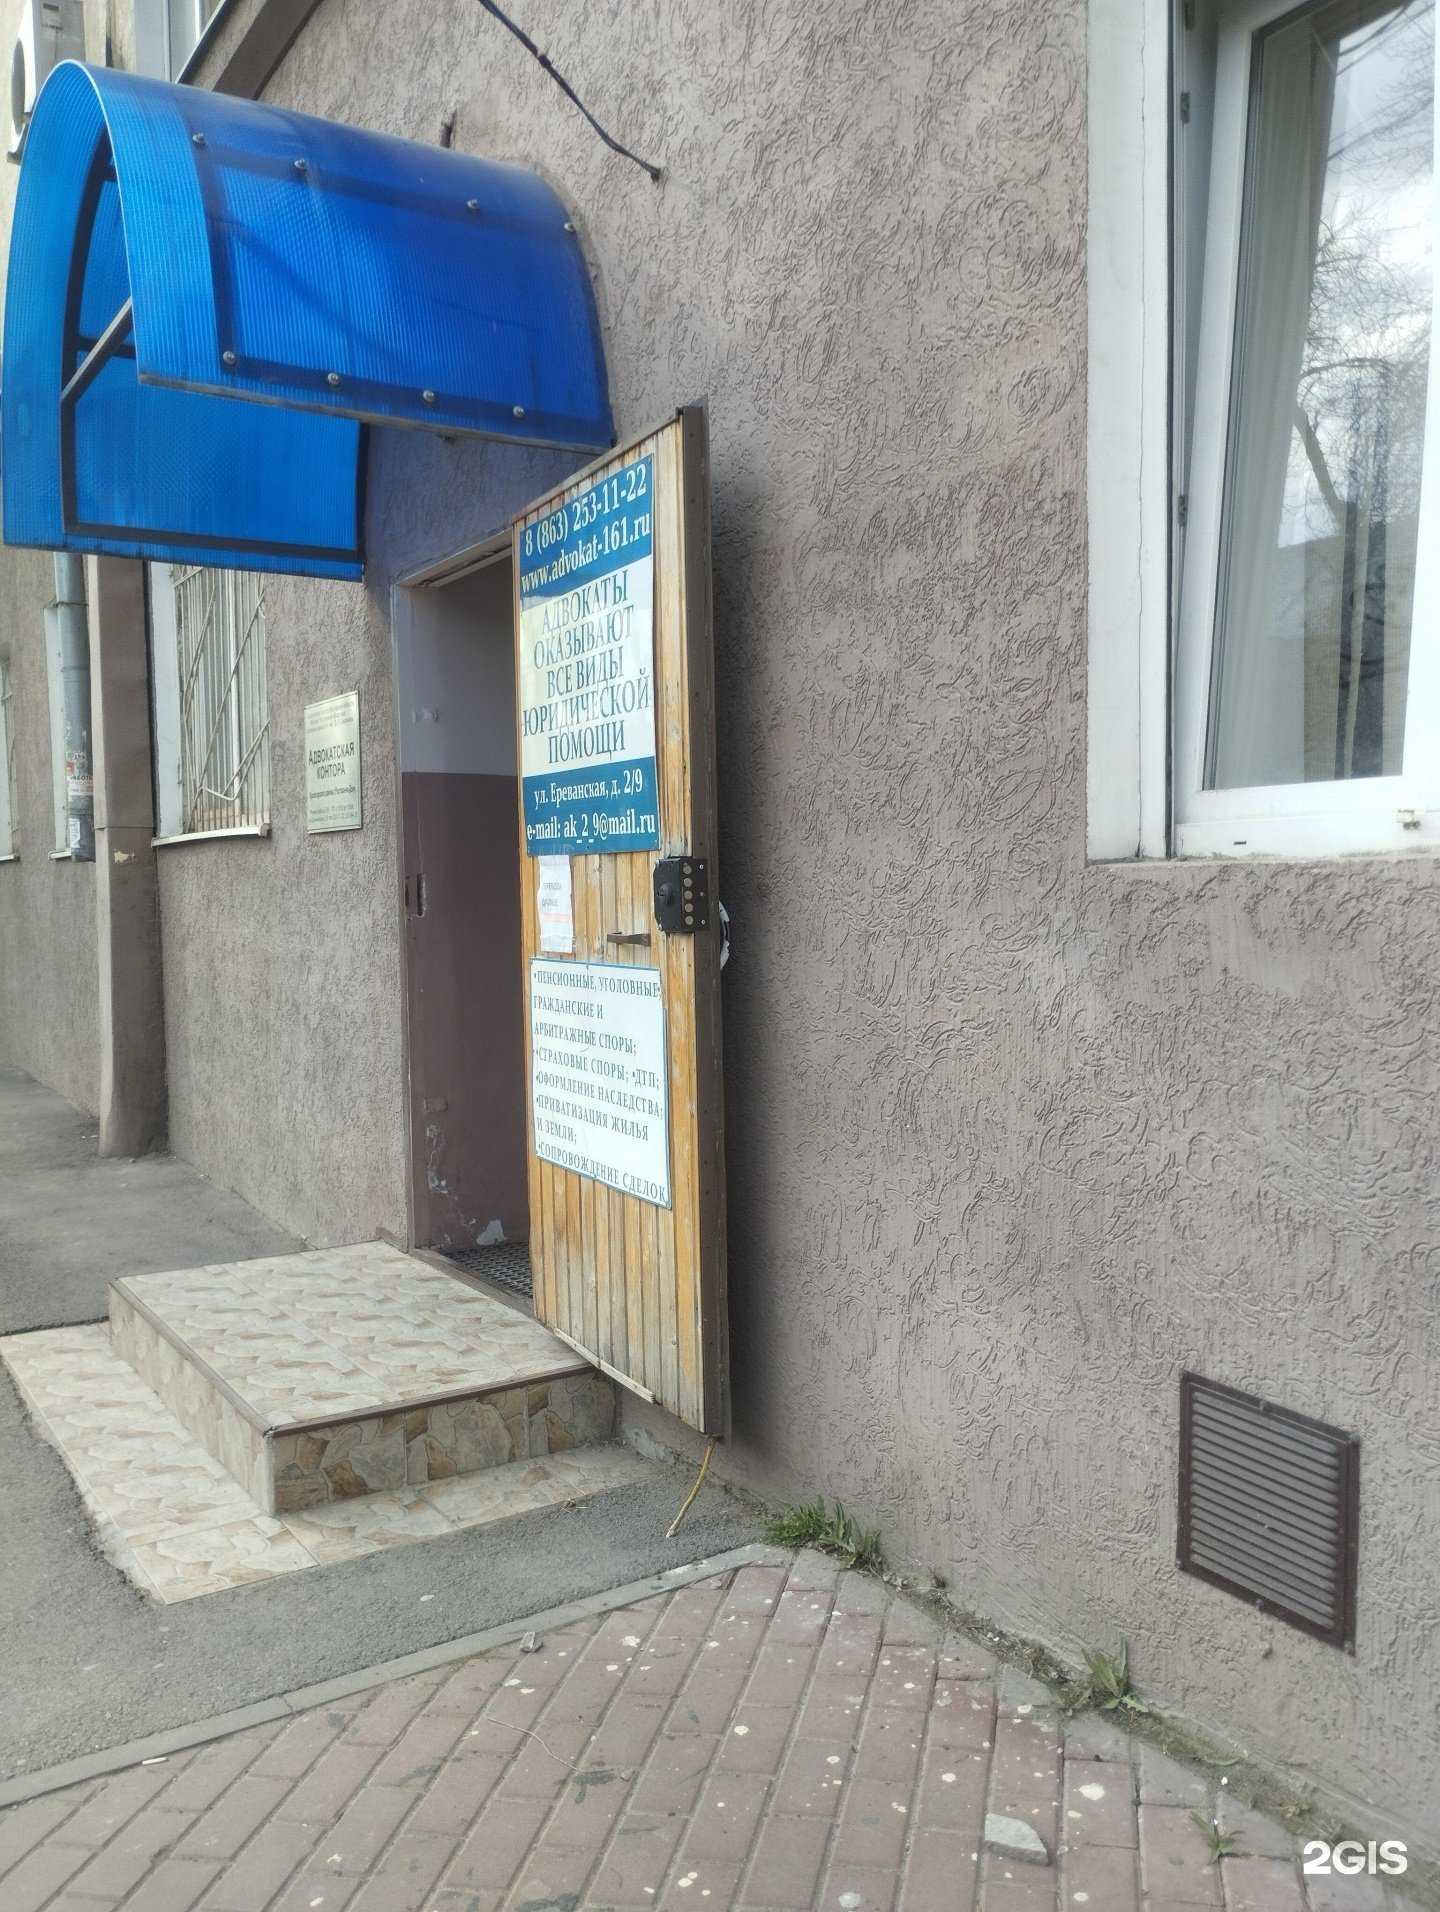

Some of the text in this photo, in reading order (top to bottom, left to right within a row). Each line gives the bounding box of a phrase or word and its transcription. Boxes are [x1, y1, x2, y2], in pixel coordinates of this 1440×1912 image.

[525, 463, 647, 556] 8 (863) 253-11-22
[521, 512, 650, 593] www.advokat-161.ru
[542, 569, 629, 635] АДВОКАТЫ
[534, 605, 634, 669] ОКАЗЫВАЮТ
[547, 646, 624, 699] ВСЕ ВИДЫ
[523, 667, 650, 736] ЮРИДИЧЕСКОЙ
[308, 741, 355, 766] АДВОКАТСКАЯ
[548, 720, 625, 764] ПОМОЩИ
[316, 761, 346, 779] КОНТОРА
[534, 768, 643, 810] ул. Ереванская, д. 2/9
[527, 816, 561, 840] e-mail:
[534, 995, 603, 1019] ГРАЖДАНСКИЕ И
[534, 1022, 637, 1056] АРБИТРАЖНЫЕ СПОРЫ;
[546, 1120, 577, 1144] ЗЕМЛИ;
[611, 1114, 649, 1141] ЖИЛЬЯ
[622, 1172, 666, 1201] СДЕЛОК
